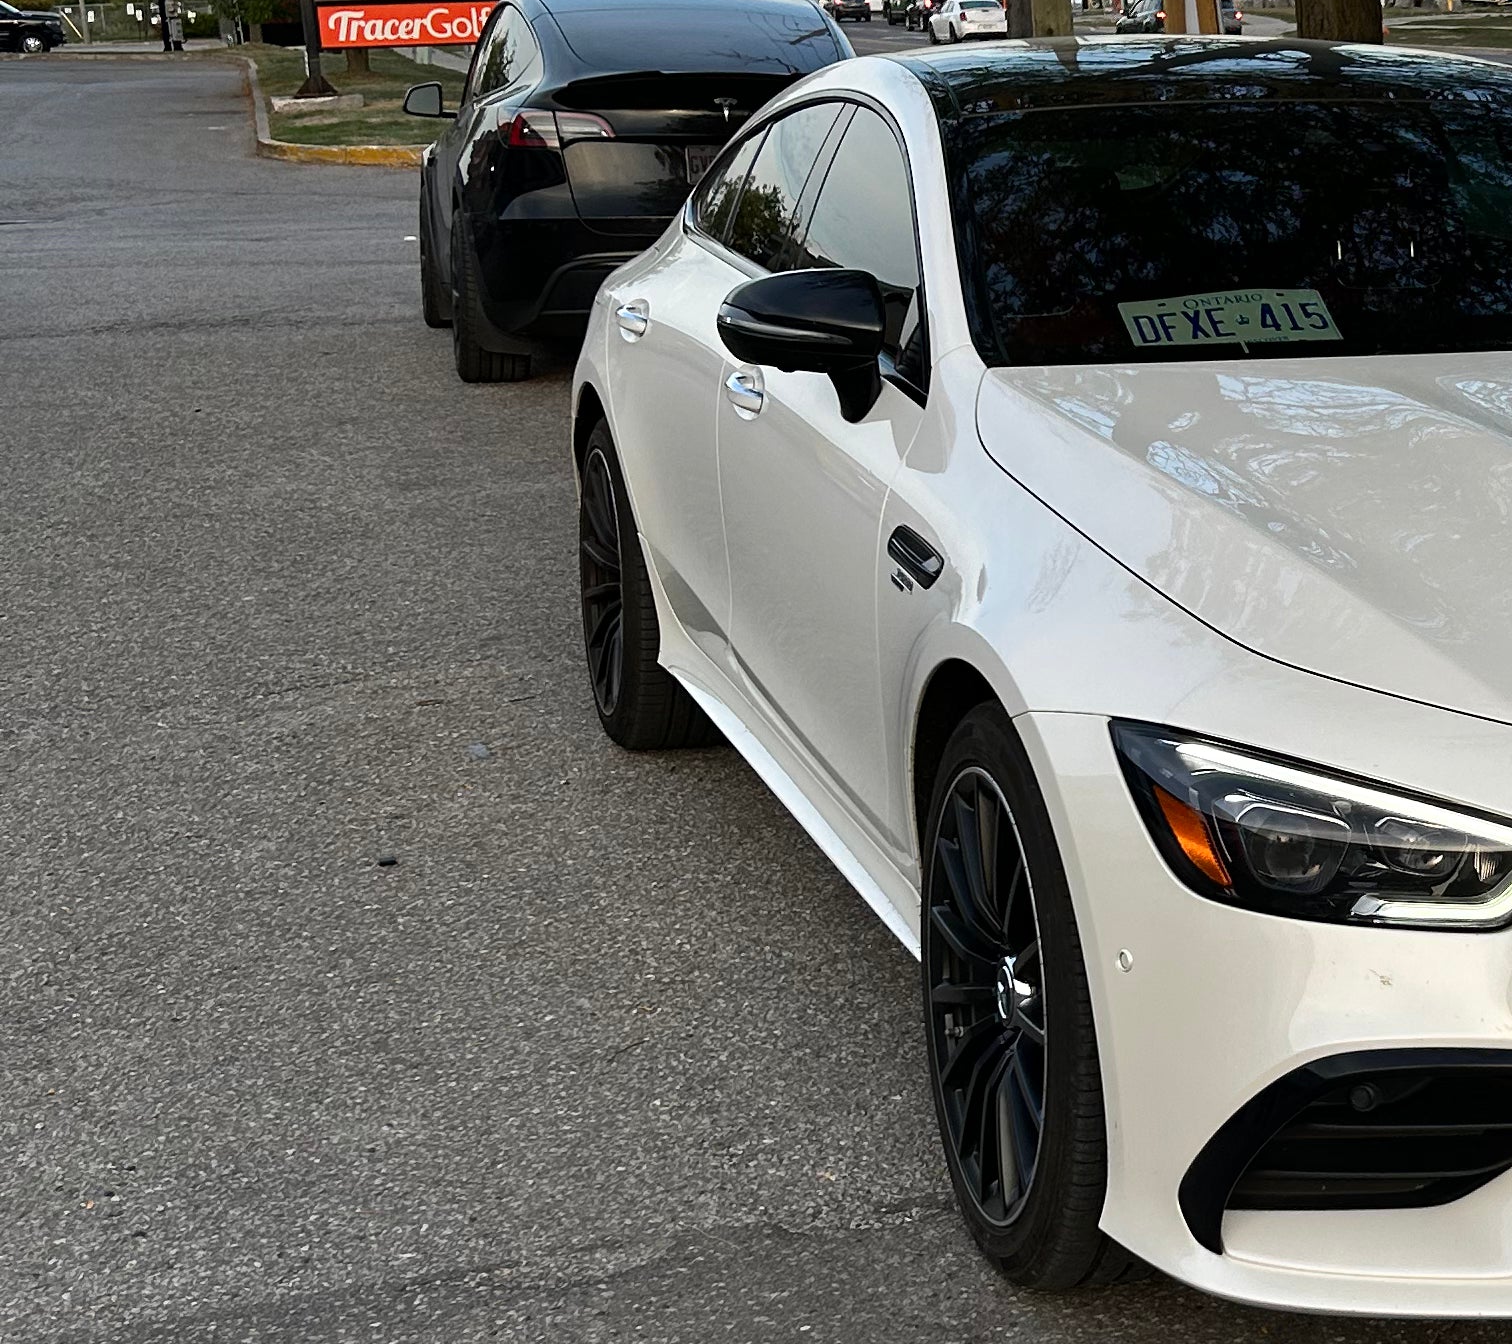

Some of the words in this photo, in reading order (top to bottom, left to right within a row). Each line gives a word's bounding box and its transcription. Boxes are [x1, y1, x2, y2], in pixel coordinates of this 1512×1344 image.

[1183, 293, 1262, 310] ONTARIO
[1132, 307, 1236, 344] DFXE
[1260, 302, 1329, 332] 415
